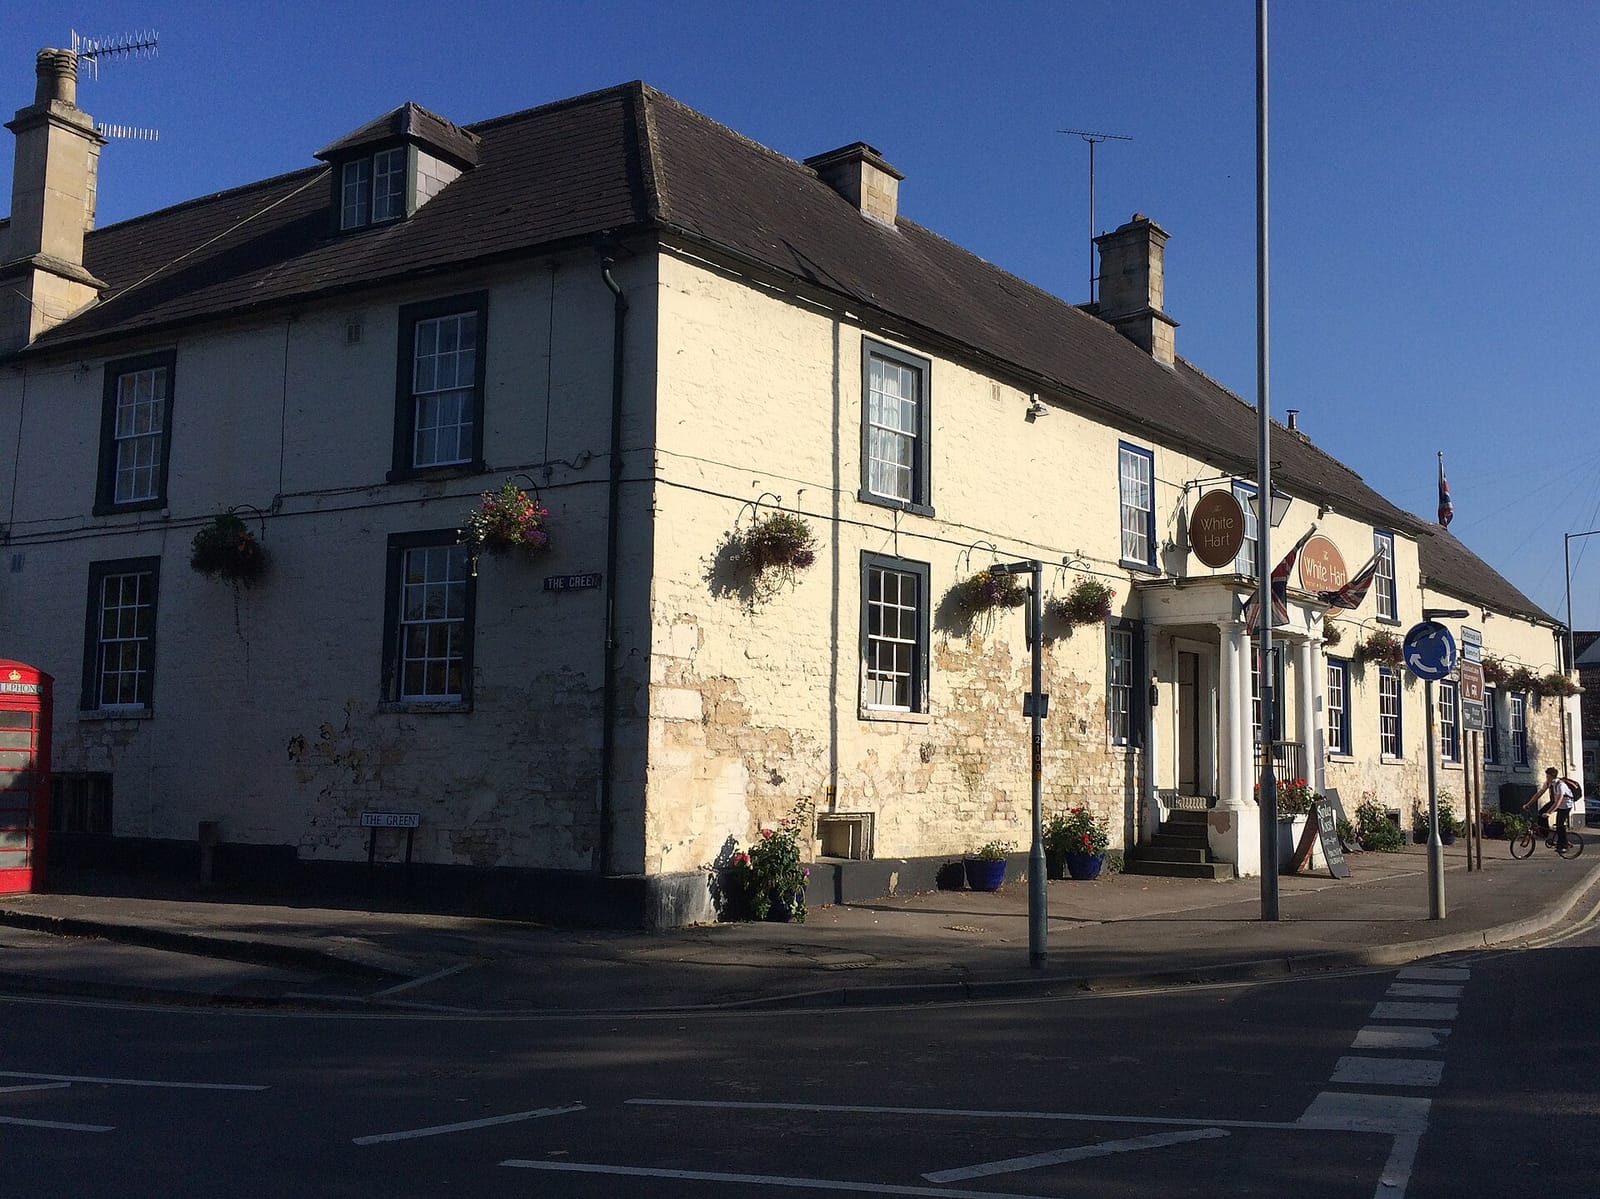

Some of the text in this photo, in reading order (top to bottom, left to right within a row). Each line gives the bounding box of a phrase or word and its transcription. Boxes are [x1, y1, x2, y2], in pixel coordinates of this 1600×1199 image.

[1200, 517, 1234, 531] White
[1204, 532, 1230, 548] Hart
[1303, 555, 1328, 582] White
[1329, 564, 1346, 587] Hart
[547, 578, 565, 589] THE
[364, 814, 417, 826] THE GREEN
